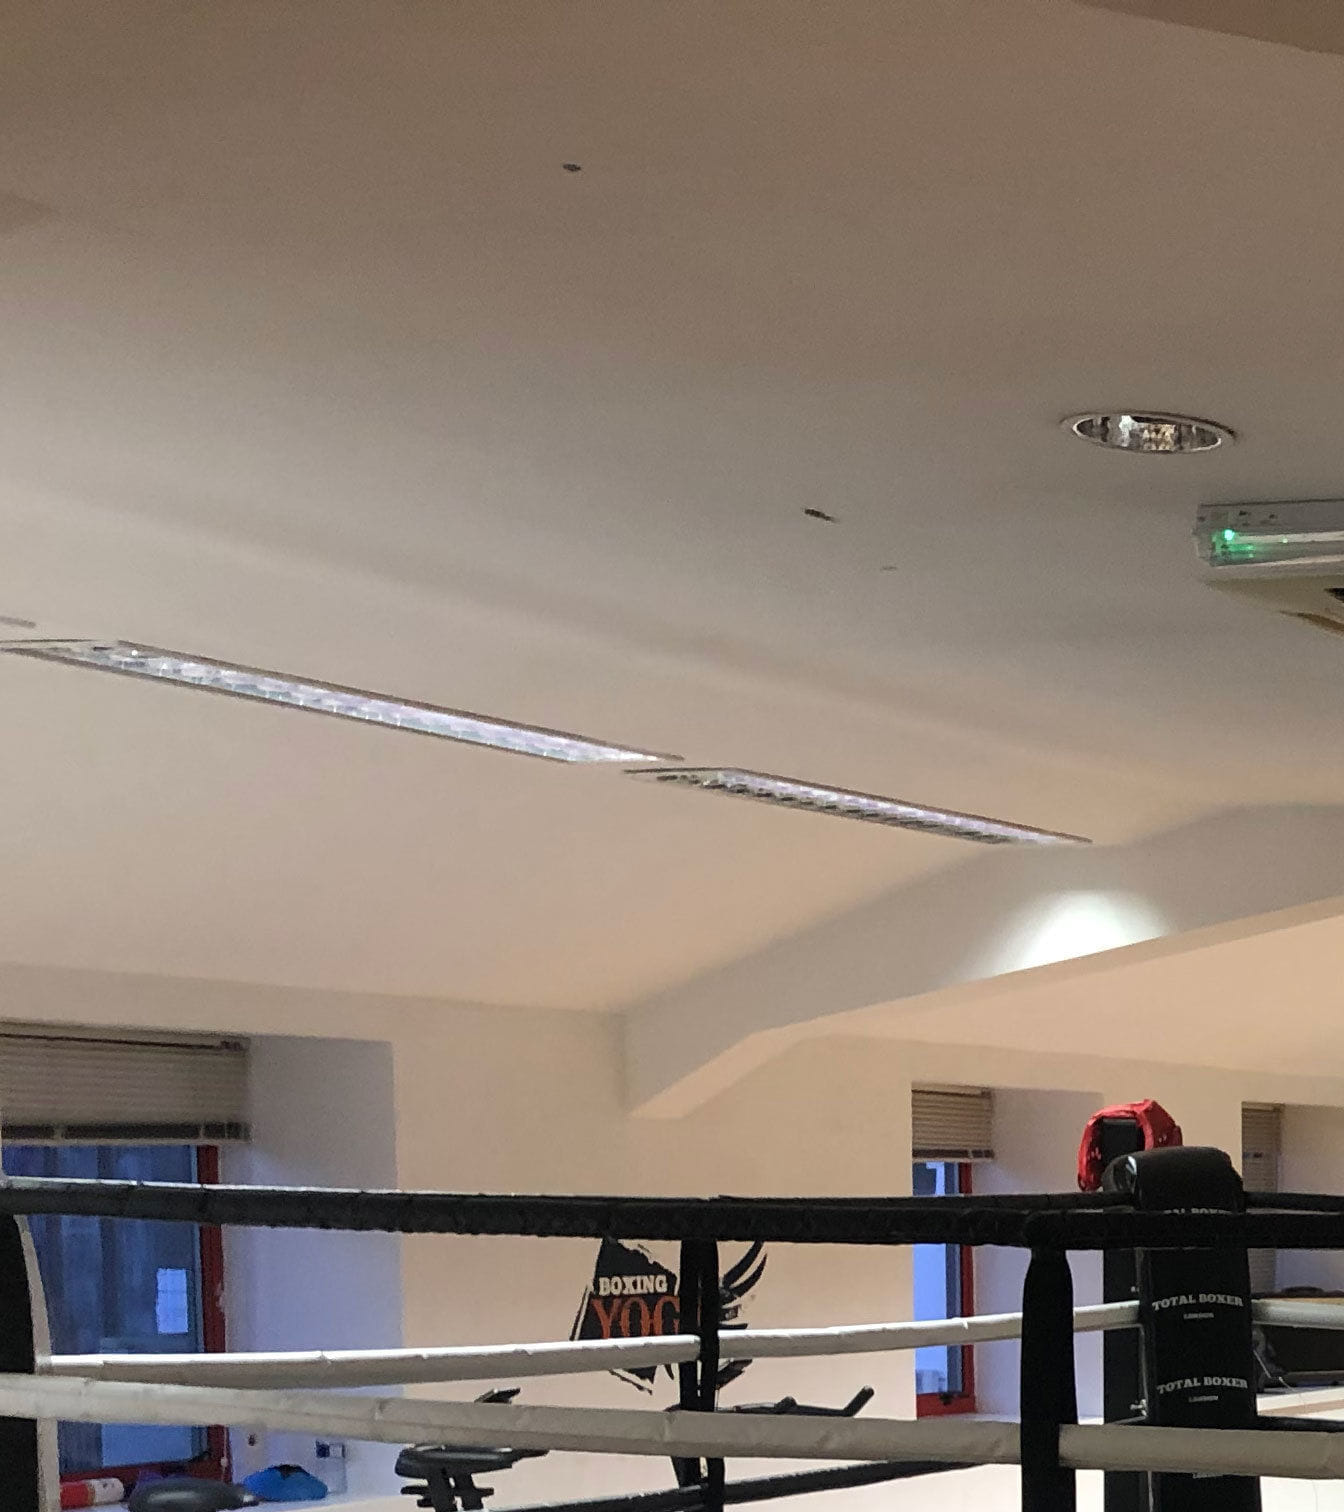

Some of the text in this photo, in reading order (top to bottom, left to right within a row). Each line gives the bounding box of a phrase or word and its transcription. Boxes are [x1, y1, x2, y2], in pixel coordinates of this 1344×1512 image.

[598, 1275, 668, 1296] BOXING
[1152, 1293, 1244, 1311] TOTAL BOXER
[1157, 1376, 1248, 1394] TOTAL BOXER
